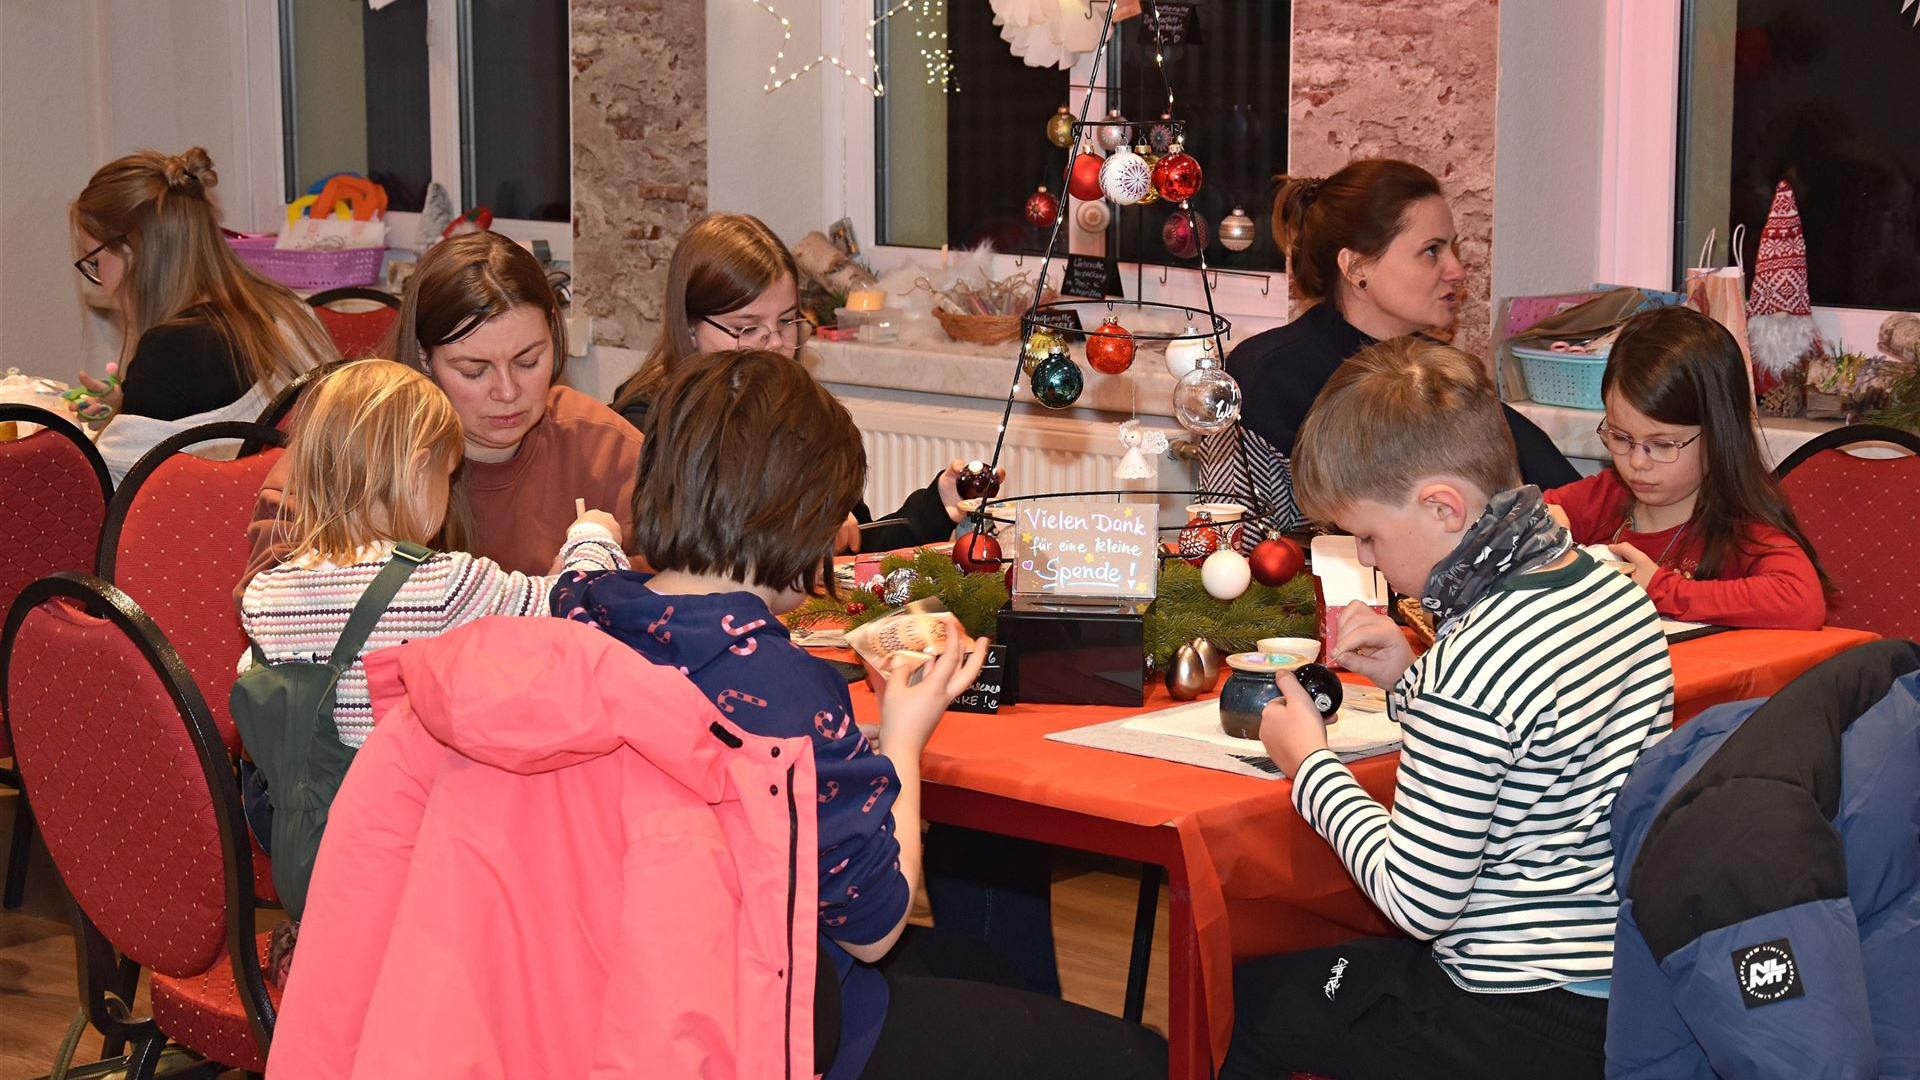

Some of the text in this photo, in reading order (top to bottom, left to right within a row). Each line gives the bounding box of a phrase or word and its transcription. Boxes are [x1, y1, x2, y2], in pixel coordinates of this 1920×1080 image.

[1024, 507, 1147, 536] Vielen Dank
[1030, 535, 1052, 557] für
[1059, 540, 1088, 553] eine
[1034, 556, 1122, 589] Spende
